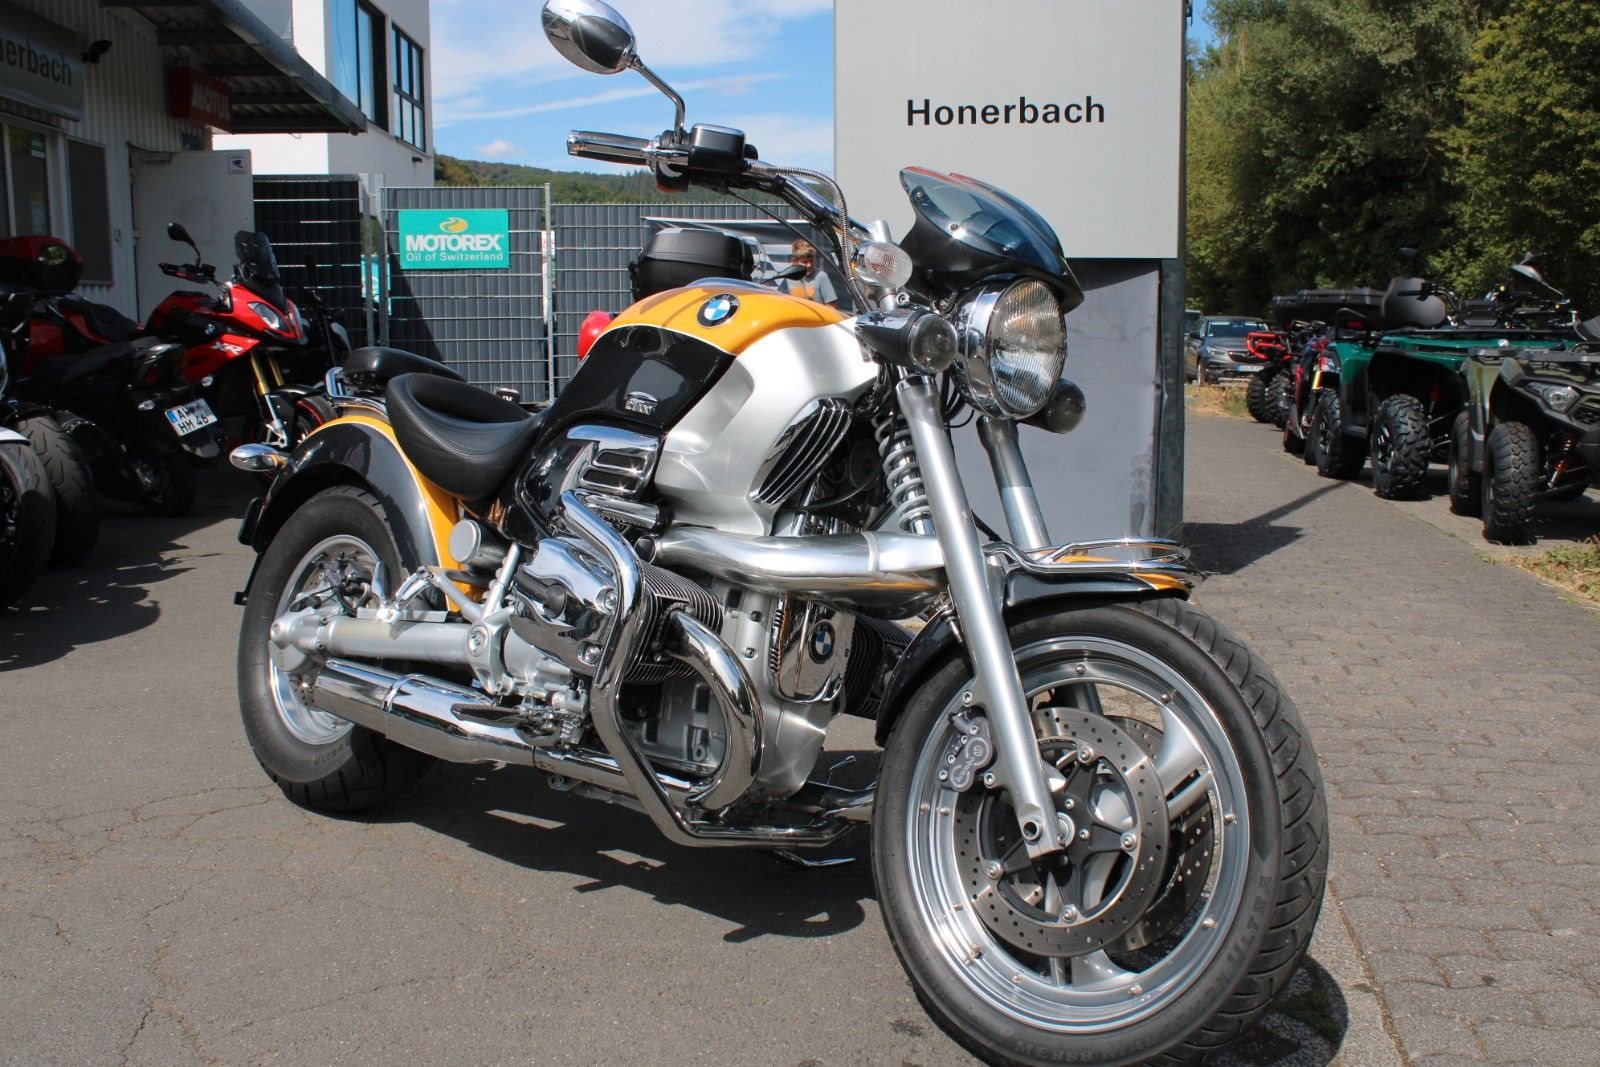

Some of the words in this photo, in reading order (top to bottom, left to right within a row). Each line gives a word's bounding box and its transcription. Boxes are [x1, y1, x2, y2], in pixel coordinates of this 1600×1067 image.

[907, 96, 1105, 126] Honerbach
[406, 234, 503, 251] MOTOREX
[406, 252, 421, 262] Oil
[425, 253, 437, 261] of
[440, 251, 504, 261] Switzerland
